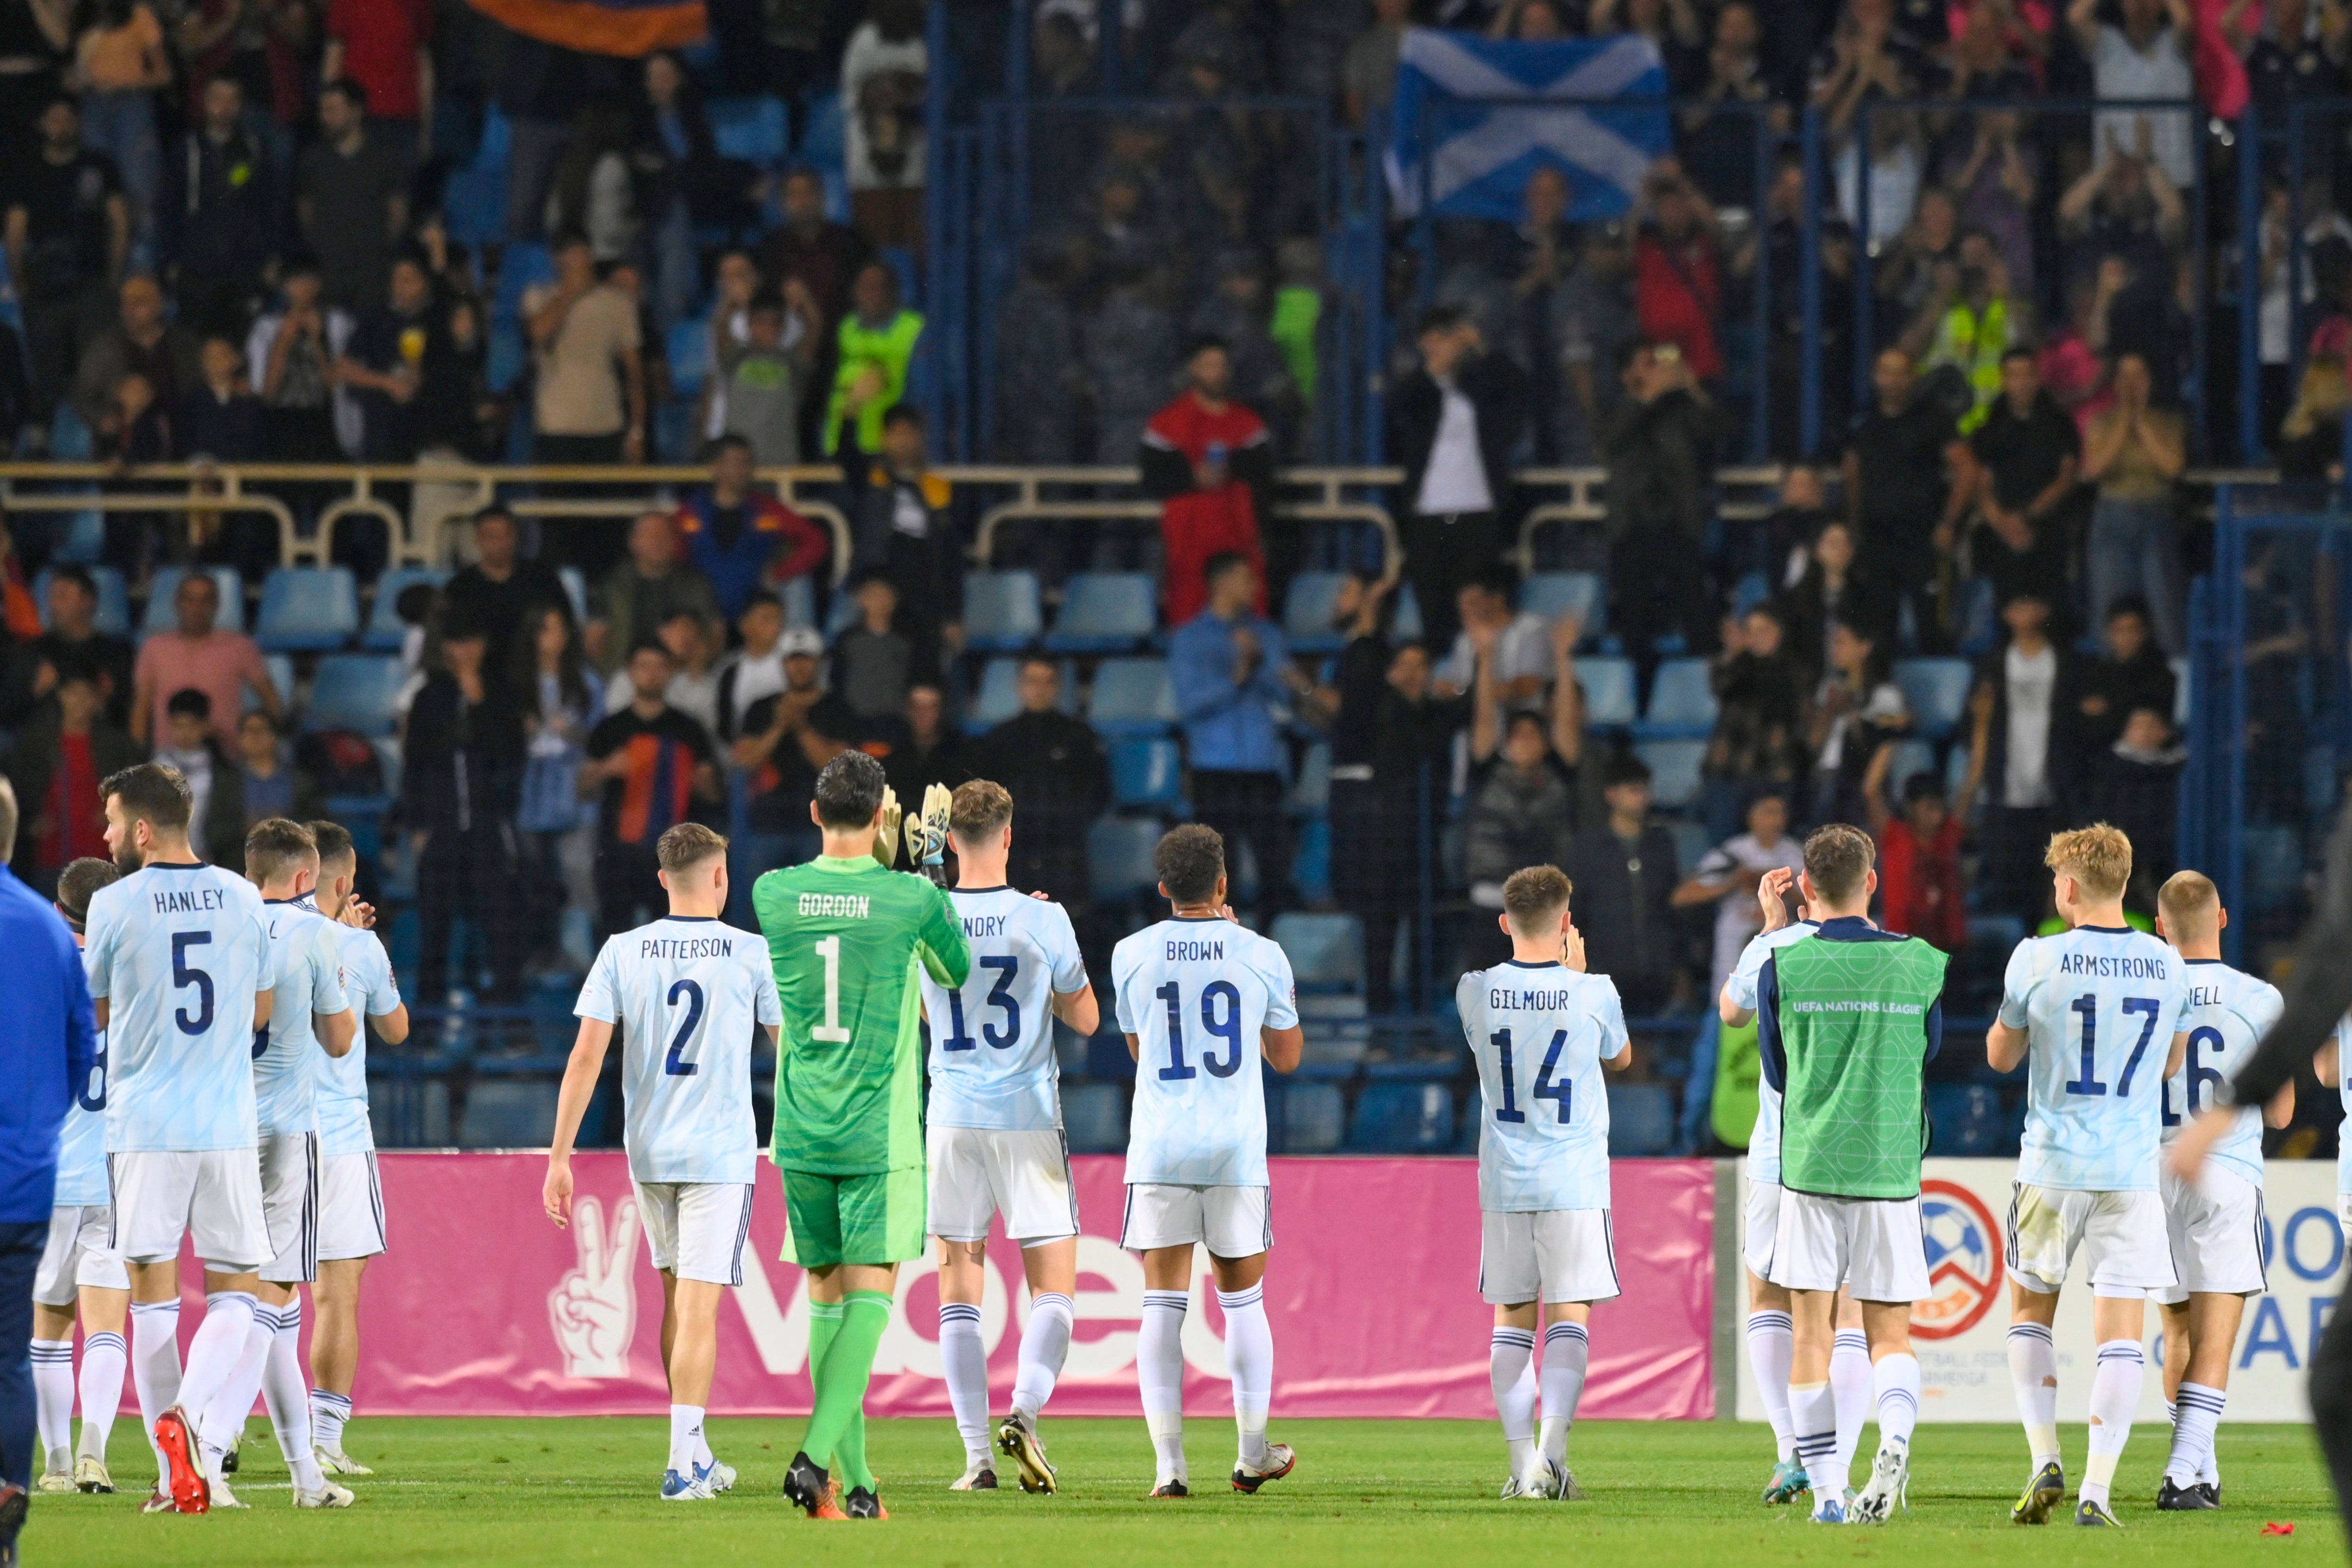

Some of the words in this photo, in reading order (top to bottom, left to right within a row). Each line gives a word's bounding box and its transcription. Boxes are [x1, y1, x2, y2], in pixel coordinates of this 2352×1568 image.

[154, 889, 224, 914] HANLEY
[798, 894, 870, 919] GORDON
[960, 916, 1006, 937] NDRY
[642, 939, 732, 959] PATTERSON
[1167, 941, 1224, 961] BROWN
[2061, 953, 2166, 980] ARMSTRONG
[172, 931, 215, 1036] 5
[812, 936, 850, 1043] 1
[2189, 986, 2222, 1006] ELL
[943, 955, 1021, 1051] 13
[1490, 988, 1568, 1011] GILMOUR
[1793, 1002, 1823, 1012] UEFA
[1825, 1001, 1879, 1012] NATIONS
[1882, 1003, 1922, 1015] LEAGUE
[665, 979, 703, 1076] 2
[1156, 980, 1242, 1081] 19
[2066, 994, 2160, 1098] 17
[1490, 1028, 1572, 1124] 14
